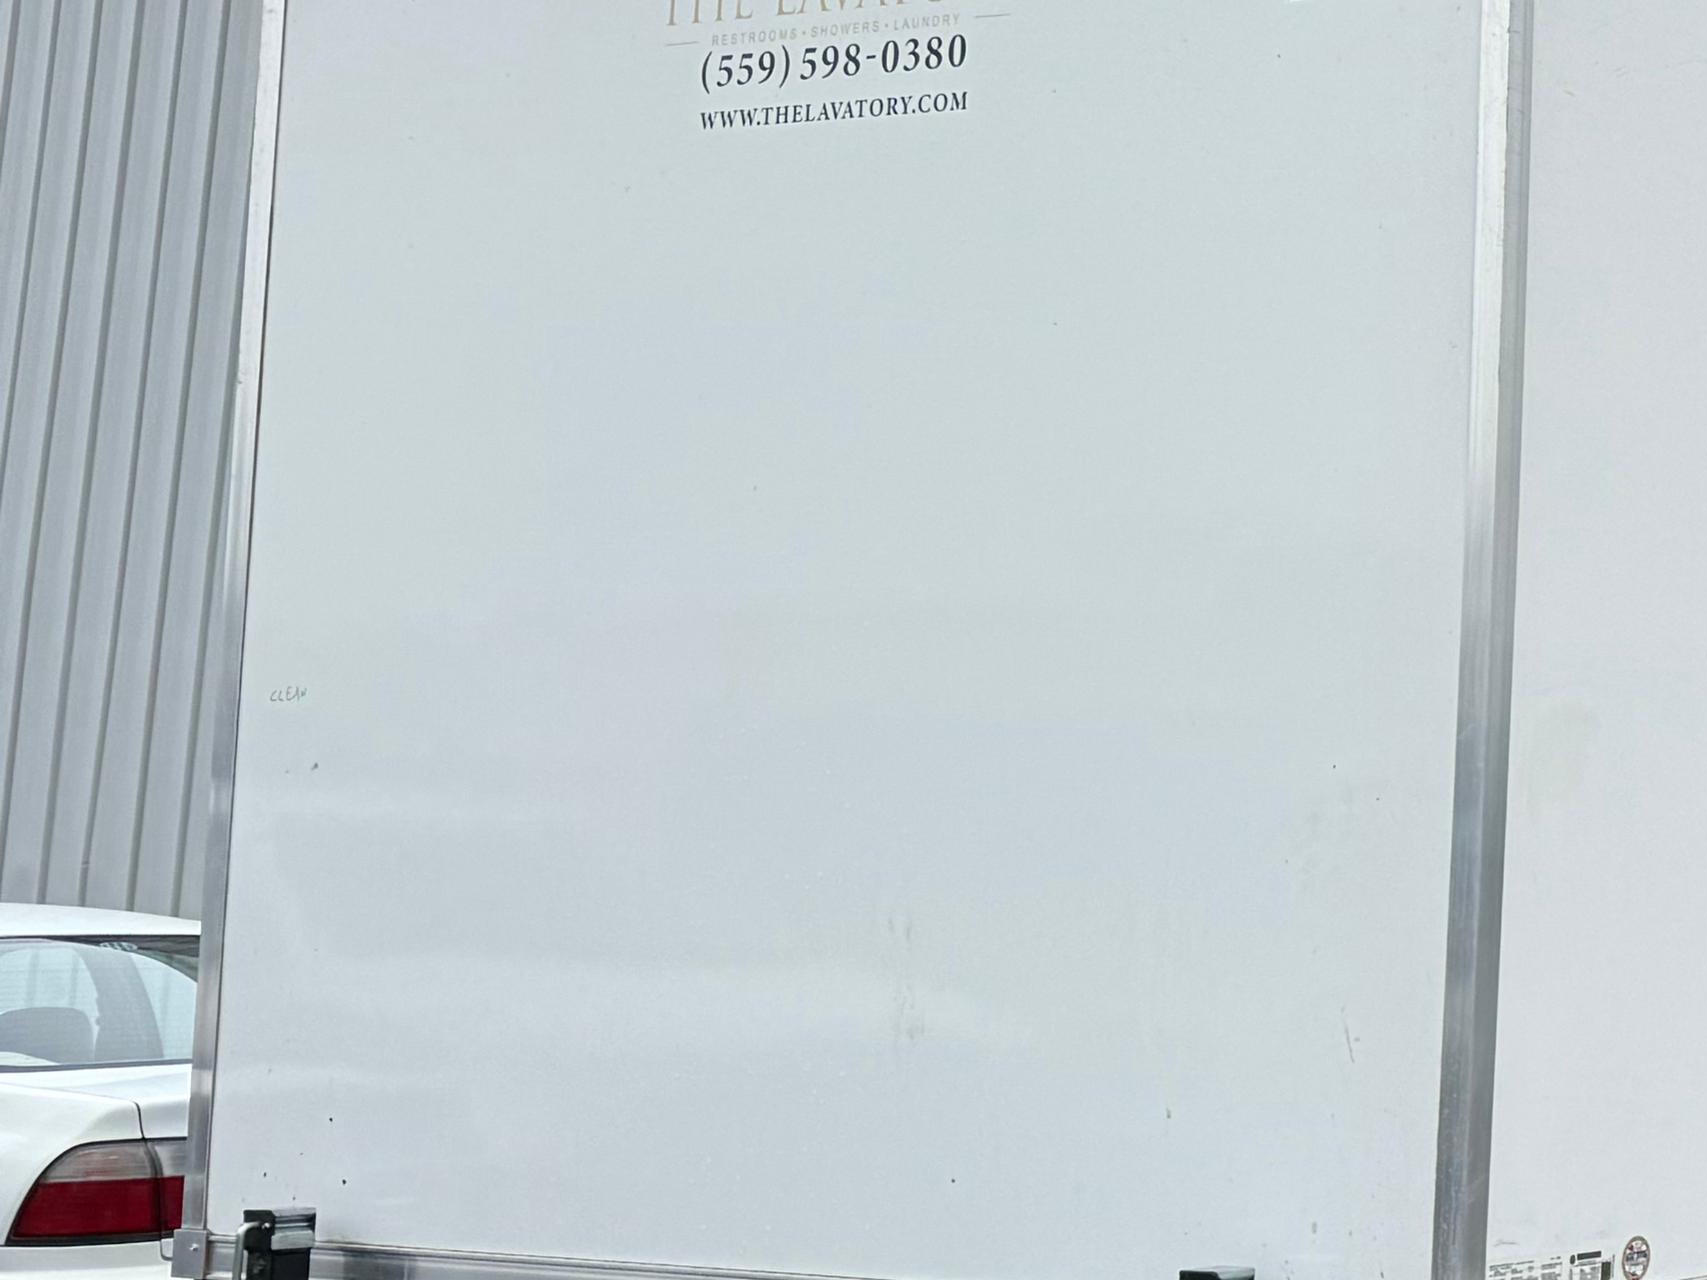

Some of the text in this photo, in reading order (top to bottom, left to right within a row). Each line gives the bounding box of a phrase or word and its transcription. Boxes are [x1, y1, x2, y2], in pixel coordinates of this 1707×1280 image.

[711, 13, 960, 47] RESTROOMS SHOWERS LAUNDRY
[701, 34, 967, 94] (559) 598-0380
[700, 91, 968, 130] WWW.THELAVATORY.COM
